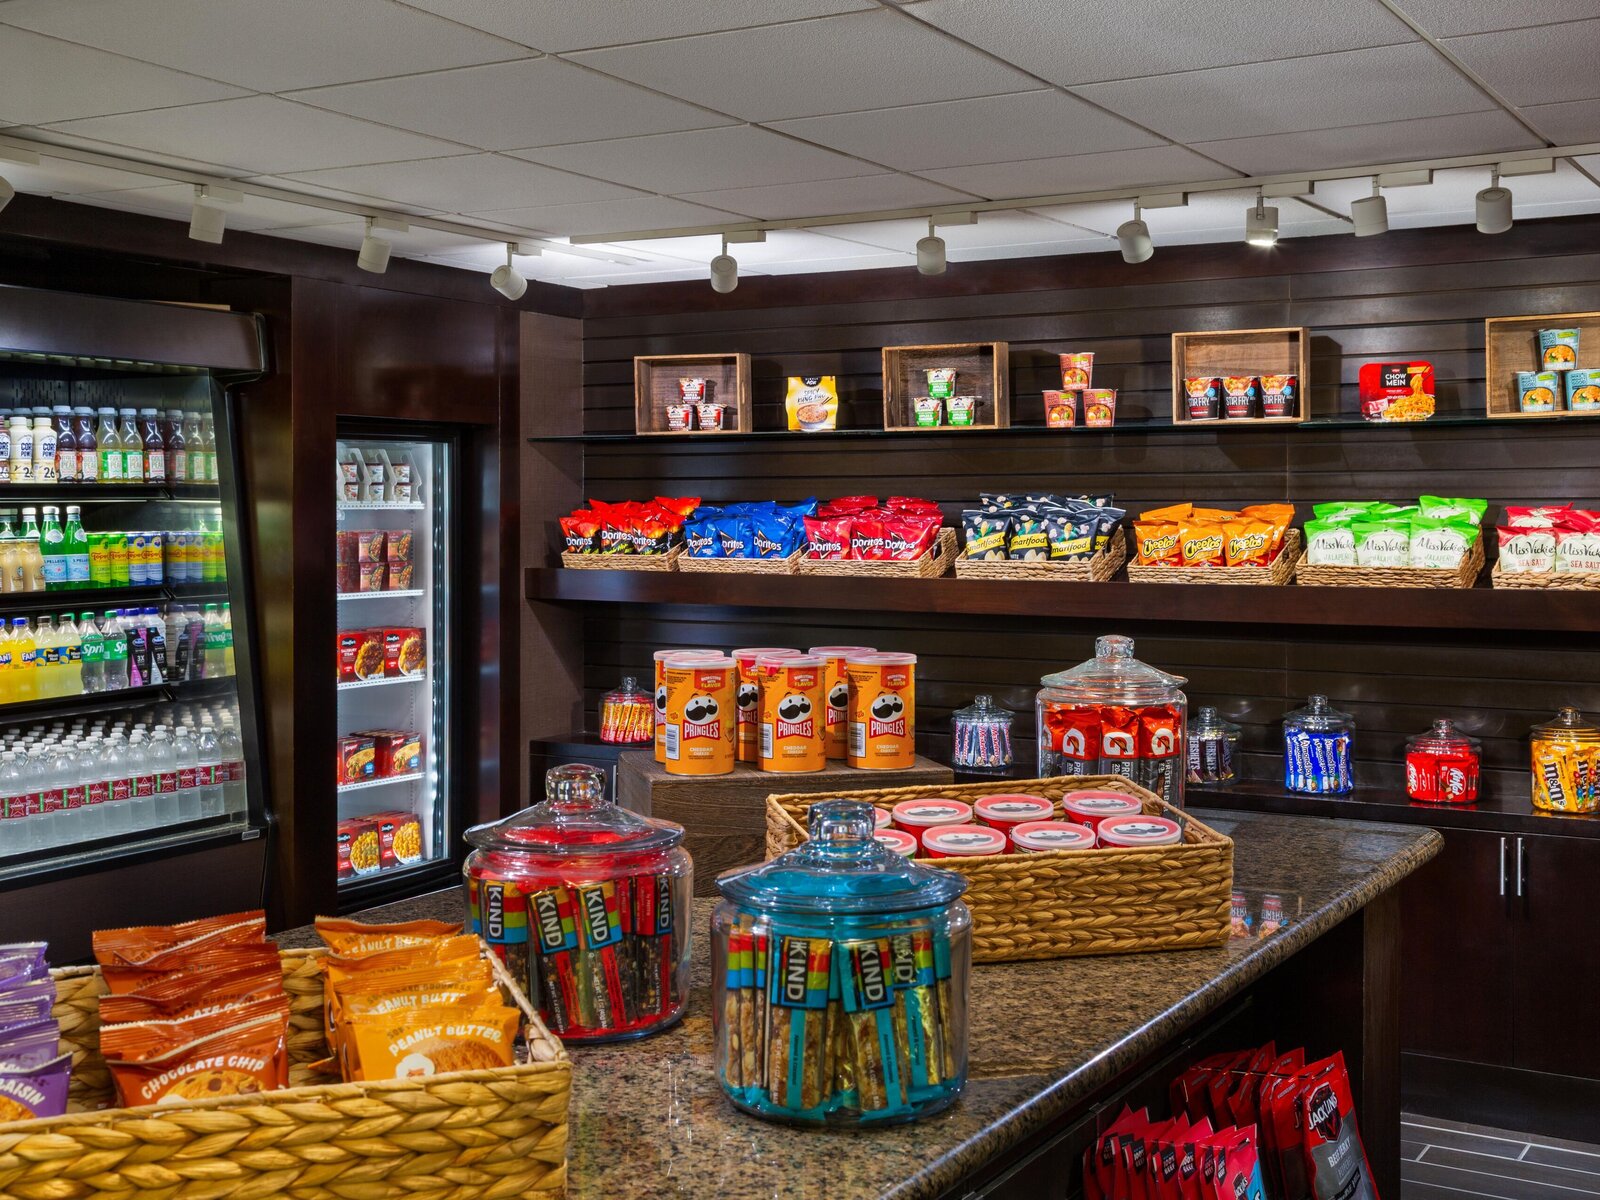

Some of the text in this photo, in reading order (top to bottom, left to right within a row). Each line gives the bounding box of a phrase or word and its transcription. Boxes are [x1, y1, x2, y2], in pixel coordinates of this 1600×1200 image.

[1198, 396, 1210, 406] FRY
[1237, 396, 1250, 406] FRY
[1274, 394, 1286, 404] FRY
[566, 537, 592, 546] Doritos
[601, 530, 632, 540] Doritos
[686, 537, 713, 548] Doritos
[753, 536, 782, 551] Doritos
[810, 542, 842, 552] Doritos
[851, 538, 884, 548] Doritos
[884, 539, 916, 550] Doritos
[1143, 536, 1178, 557] Cheetos
[1184, 537, 1221, 559] Cheetos
[1229, 535, 1264, 558] Cheetos
[1314, 539, 1335, 550] Miss
[1364, 540, 1384, 551] Miss
[1417, 538, 1440, 550] Miss
[1507, 543, 1529, 556] Miss
[1560, 543, 1584, 556] Miss
[1531, 558, 1546, 566] SALT
[1570, 560, 1582, 568] SEA
[684, 721, 718, 738] PRINGLES
[778, 720, 812, 737] PRINGLES
[870, 720, 904, 736] PRINGLES
[660, 878, 669, 928] KIND
[488, 886, 502, 938] KIND
[586, 890, 608, 942] KIND
[538, 893, 563, 947] KIND
[786, 940, 808, 1000] KIND
[860, 944, 884, 1001] KIND
[420, 992, 467, 1004] BUTT
[388, 1024, 502, 1056] PEANUT BUTTER
[141, 1056, 266, 1100] CHOCOLATE CHIP
[1309, 1100, 1330, 1130] JACK
